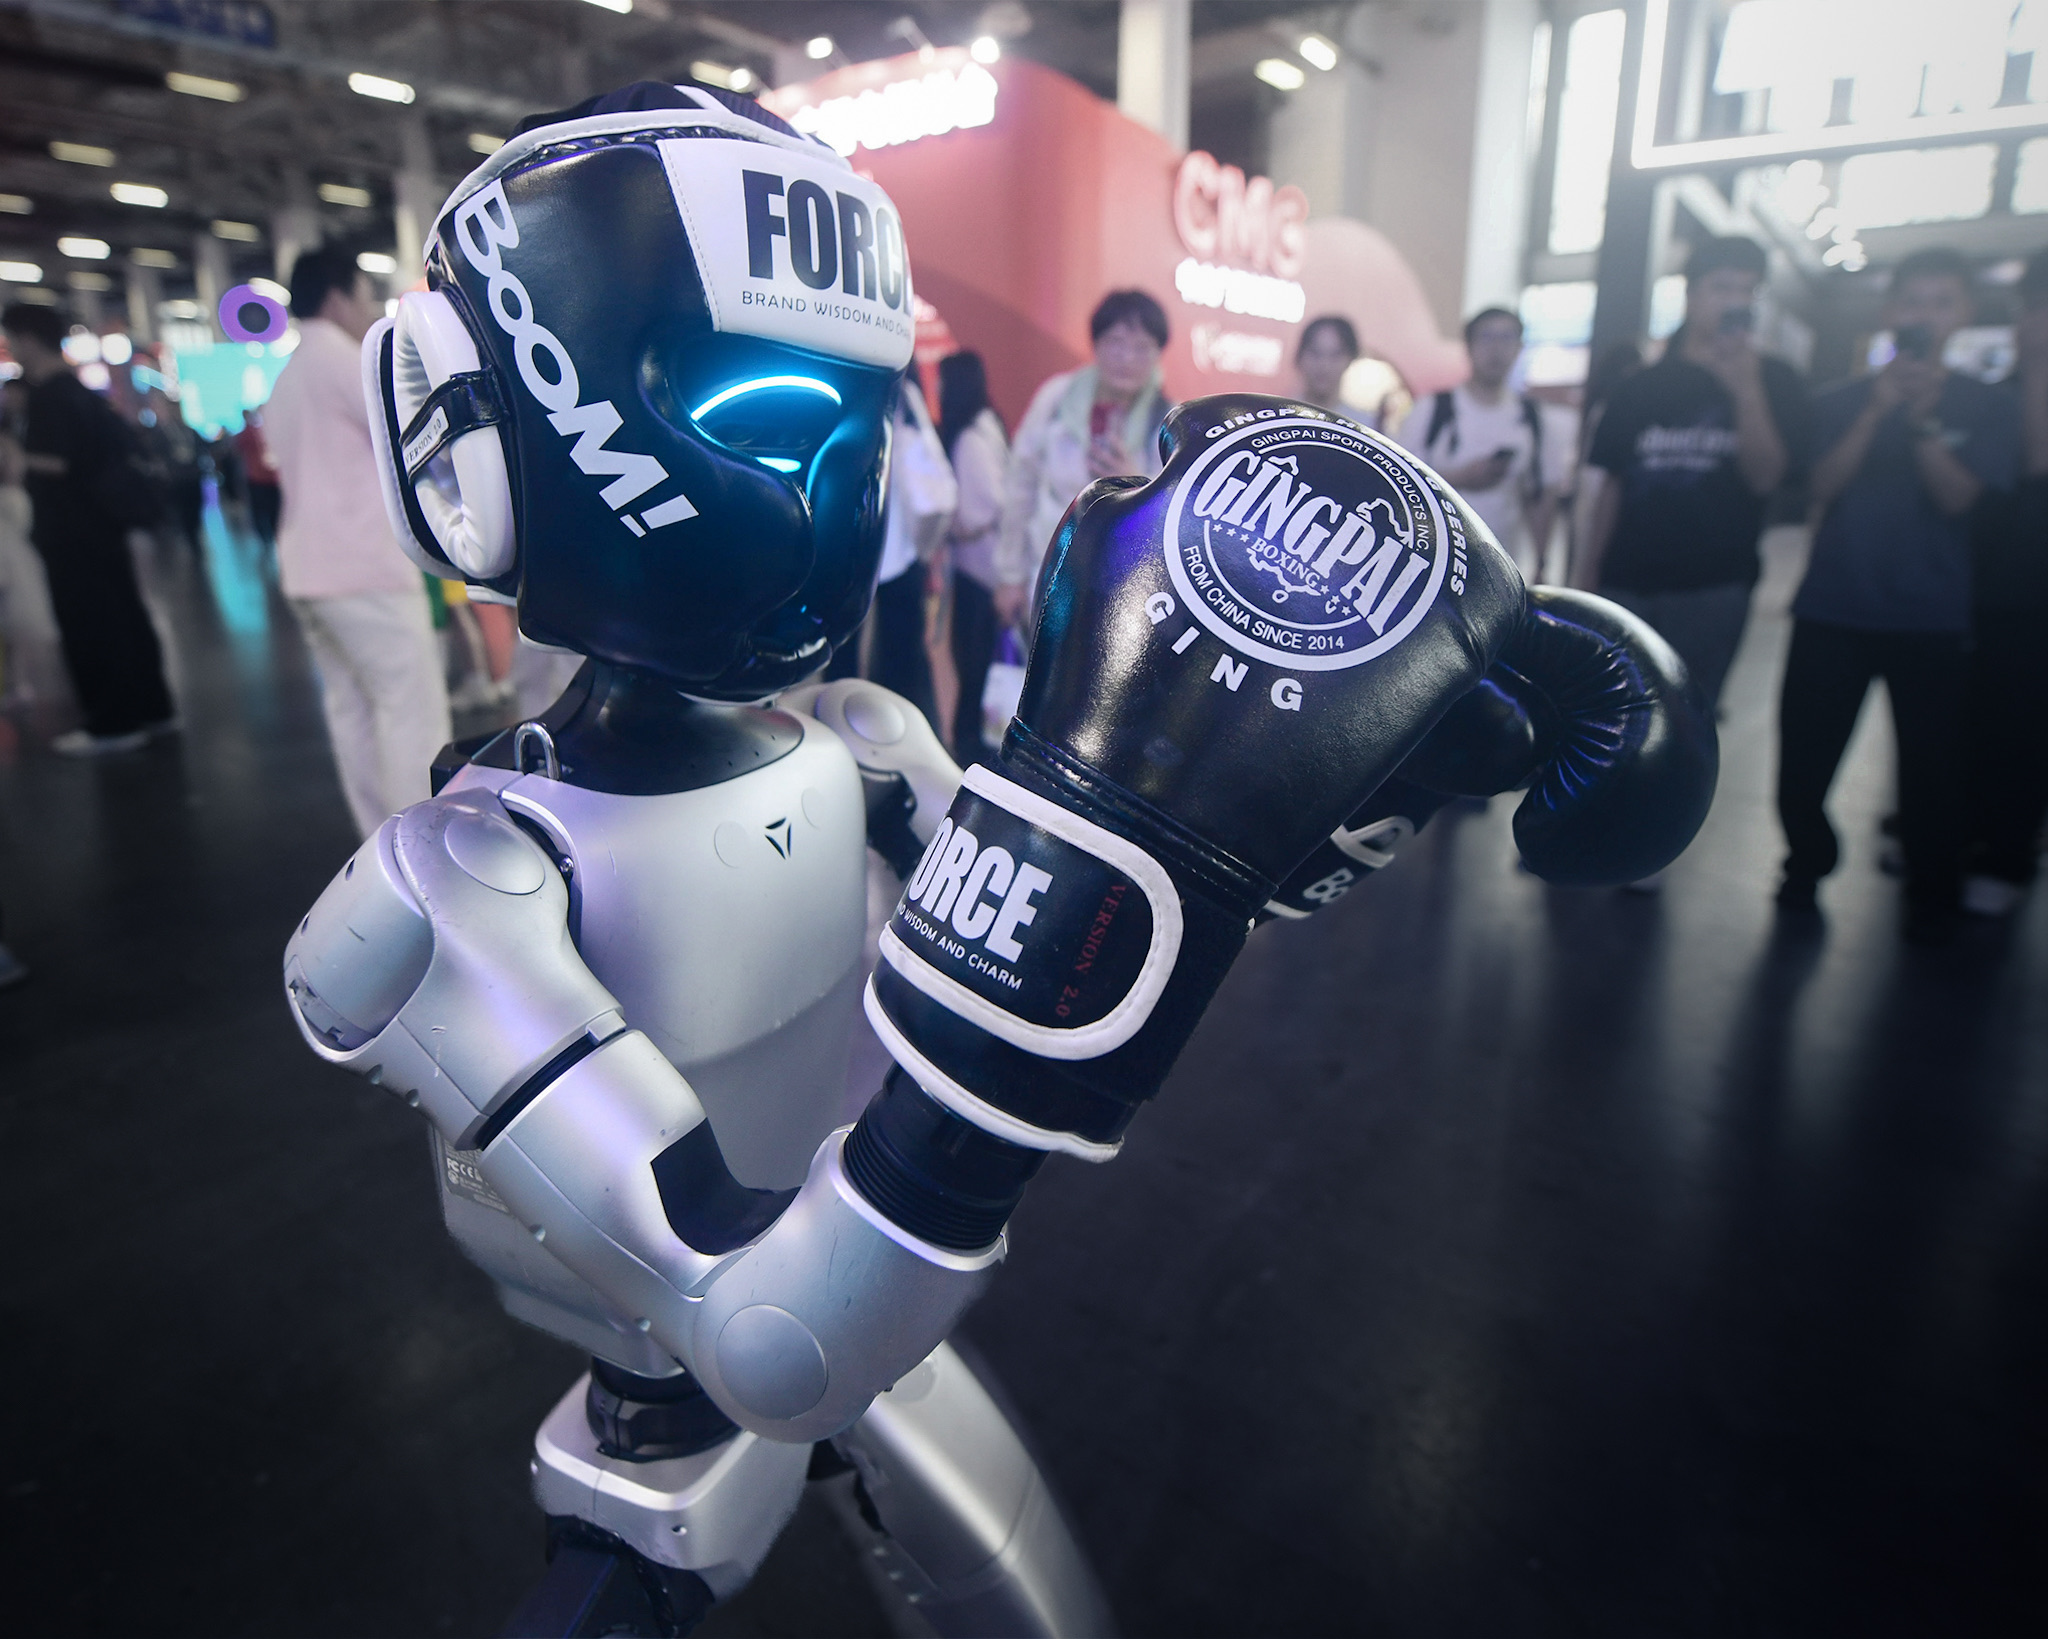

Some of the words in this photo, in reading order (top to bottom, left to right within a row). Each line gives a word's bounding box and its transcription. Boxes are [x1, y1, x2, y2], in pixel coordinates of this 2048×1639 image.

[743, 291, 807, 312] BRAND
[814, 302, 872, 325] WISDOM
[875, 316, 894, 332] AND
[454, 178, 700, 538] BOOM!
[404, 431, 433, 464] VERSION
[1205, 408, 1326, 438] GINGPAI
[1251, 430, 1316, 448] GINGPAI
[1321, 431, 1373, 454] SPORT
[1372, 453, 1427, 520] PRODUCTS
[1417, 524, 1430, 552] INC.
[1193, 450, 1430, 637] GINGPAI
[1250, 537, 1321, 588] BOXING
[1441, 499, 1468, 596] SERIES
[1183, 545, 1214, 590] FROM
[1206, 587, 1251, 630] CHINA
[1251, 620, 1303, 649] SINCE
[1307, 635, 1345, 650] 2014
[908, 816, 1053, 963] ORCE
[1075, 884, 1126, 973] VERSION
[905, 909, 938, 942] WISDOM
[937, 935, 966, 960] AND
[967, 953, 1023, 991] CHARM
[1055, 984, 1079, 1017] 2.0
